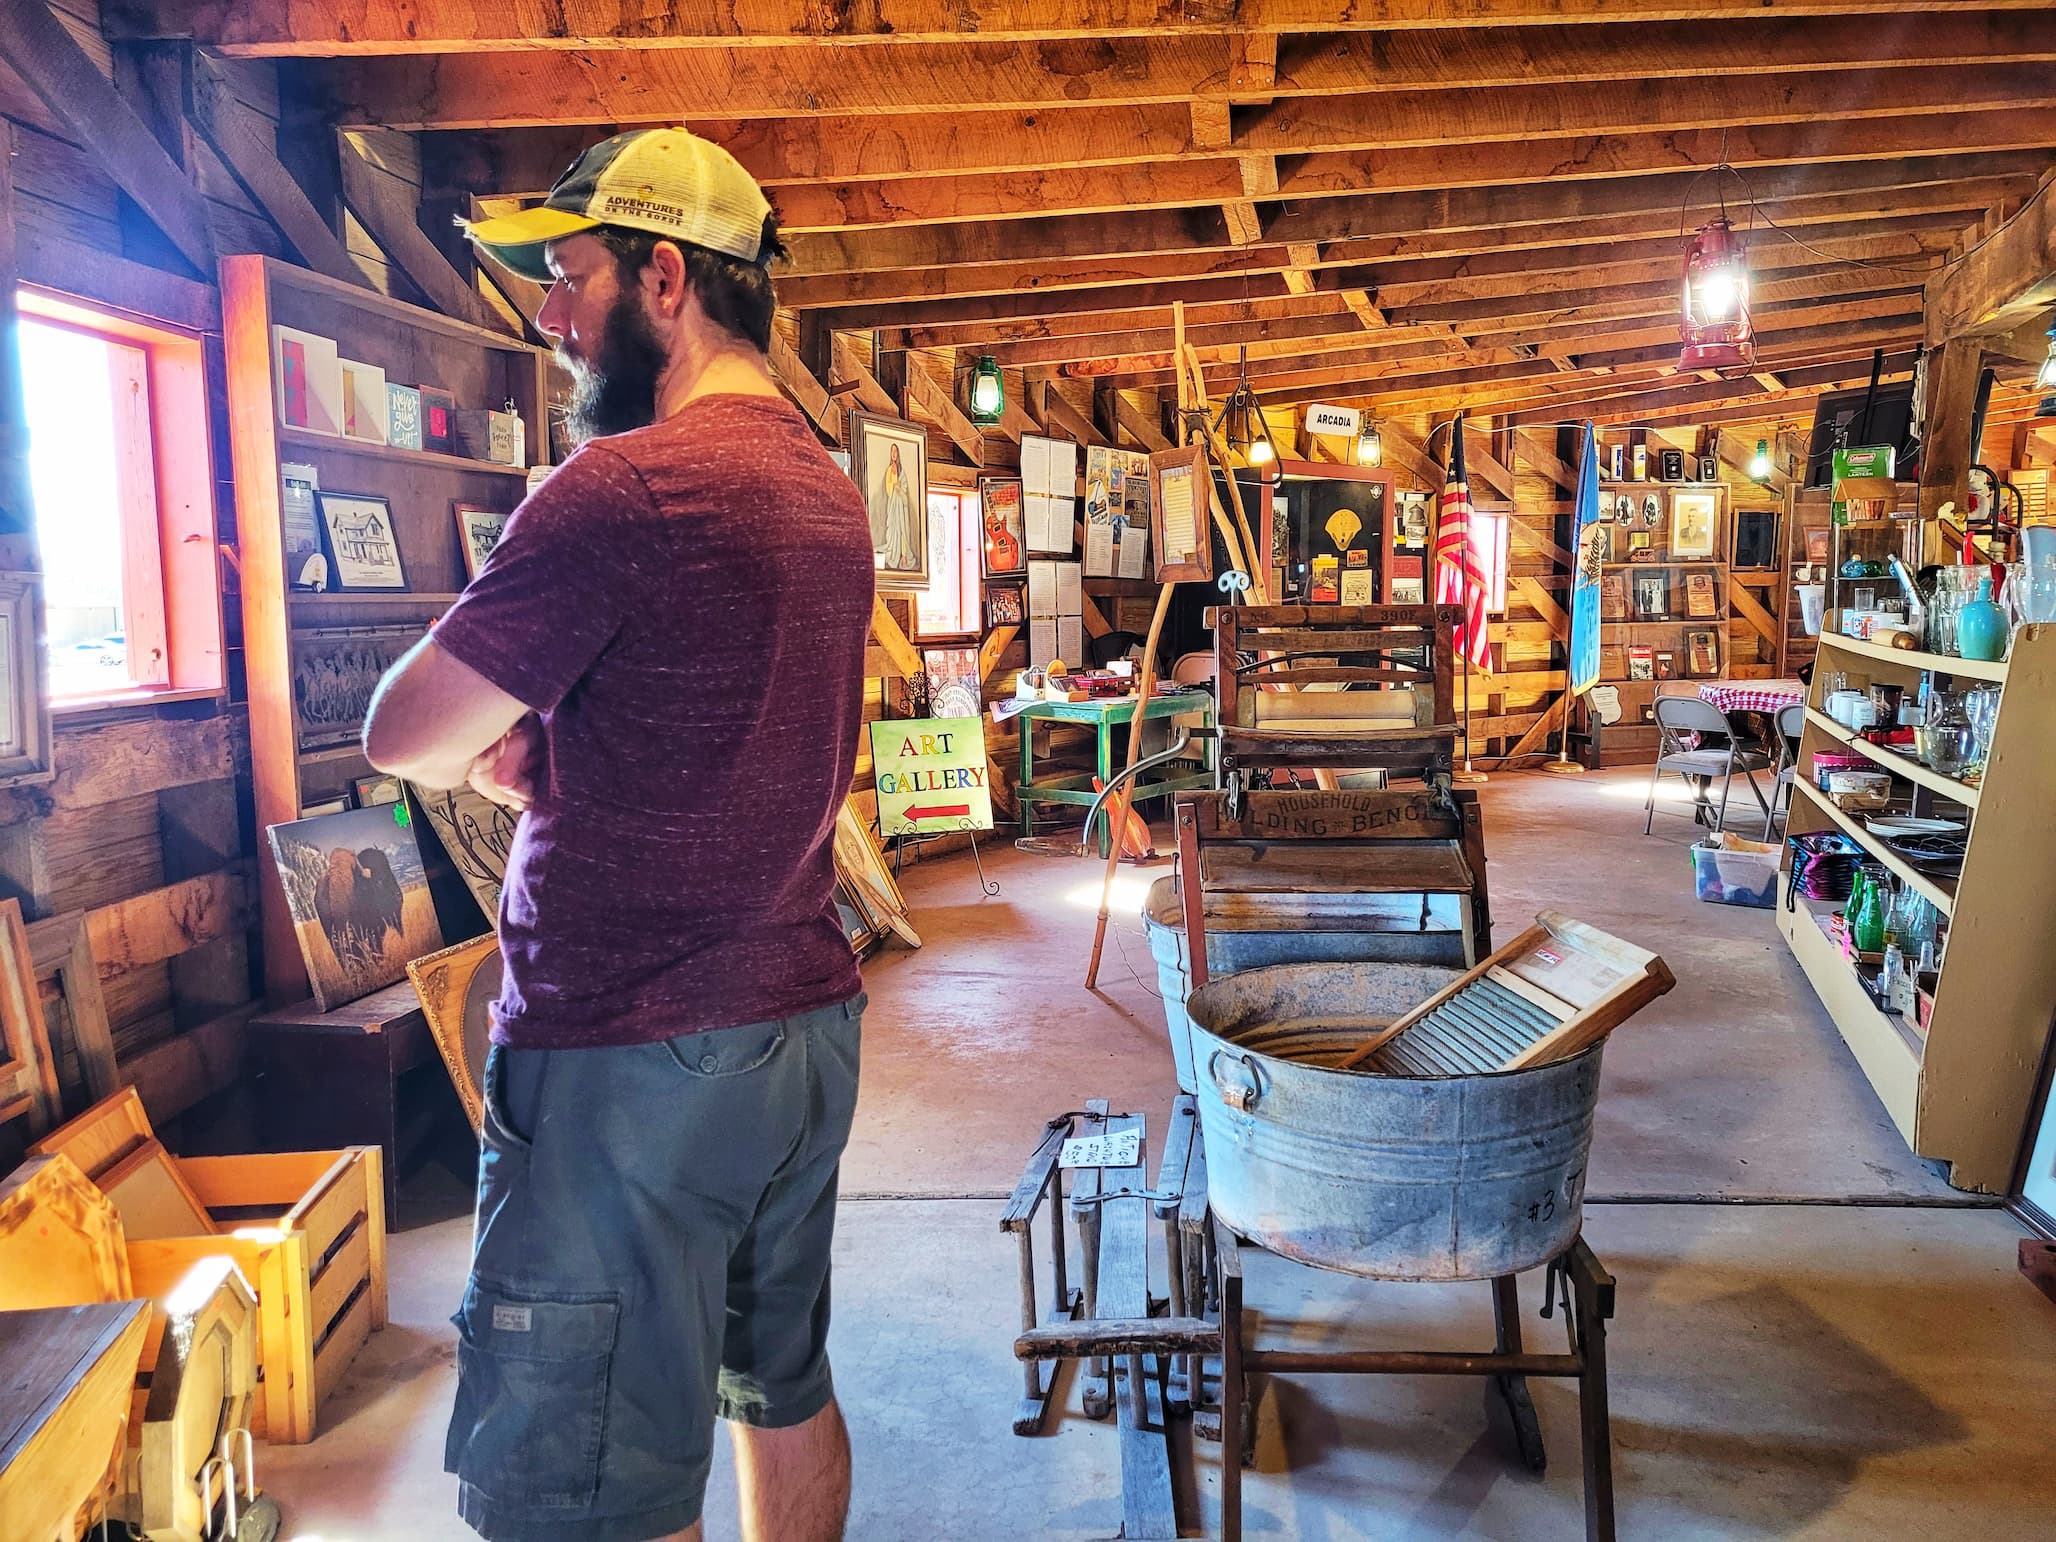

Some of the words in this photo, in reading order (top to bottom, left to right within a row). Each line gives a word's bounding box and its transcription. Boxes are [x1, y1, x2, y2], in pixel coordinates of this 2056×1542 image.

[606, 196, 684, 217] ADVENTURES
[1316, 413, 1351, 427] ARCADIA
[899, 733, 954, 757] ART
[879, 767, 985, 794] GALLERY
[1277, 793, 1372, 814] HOUSEHOLD
[1528, 1190, 1555, 1222] #3
